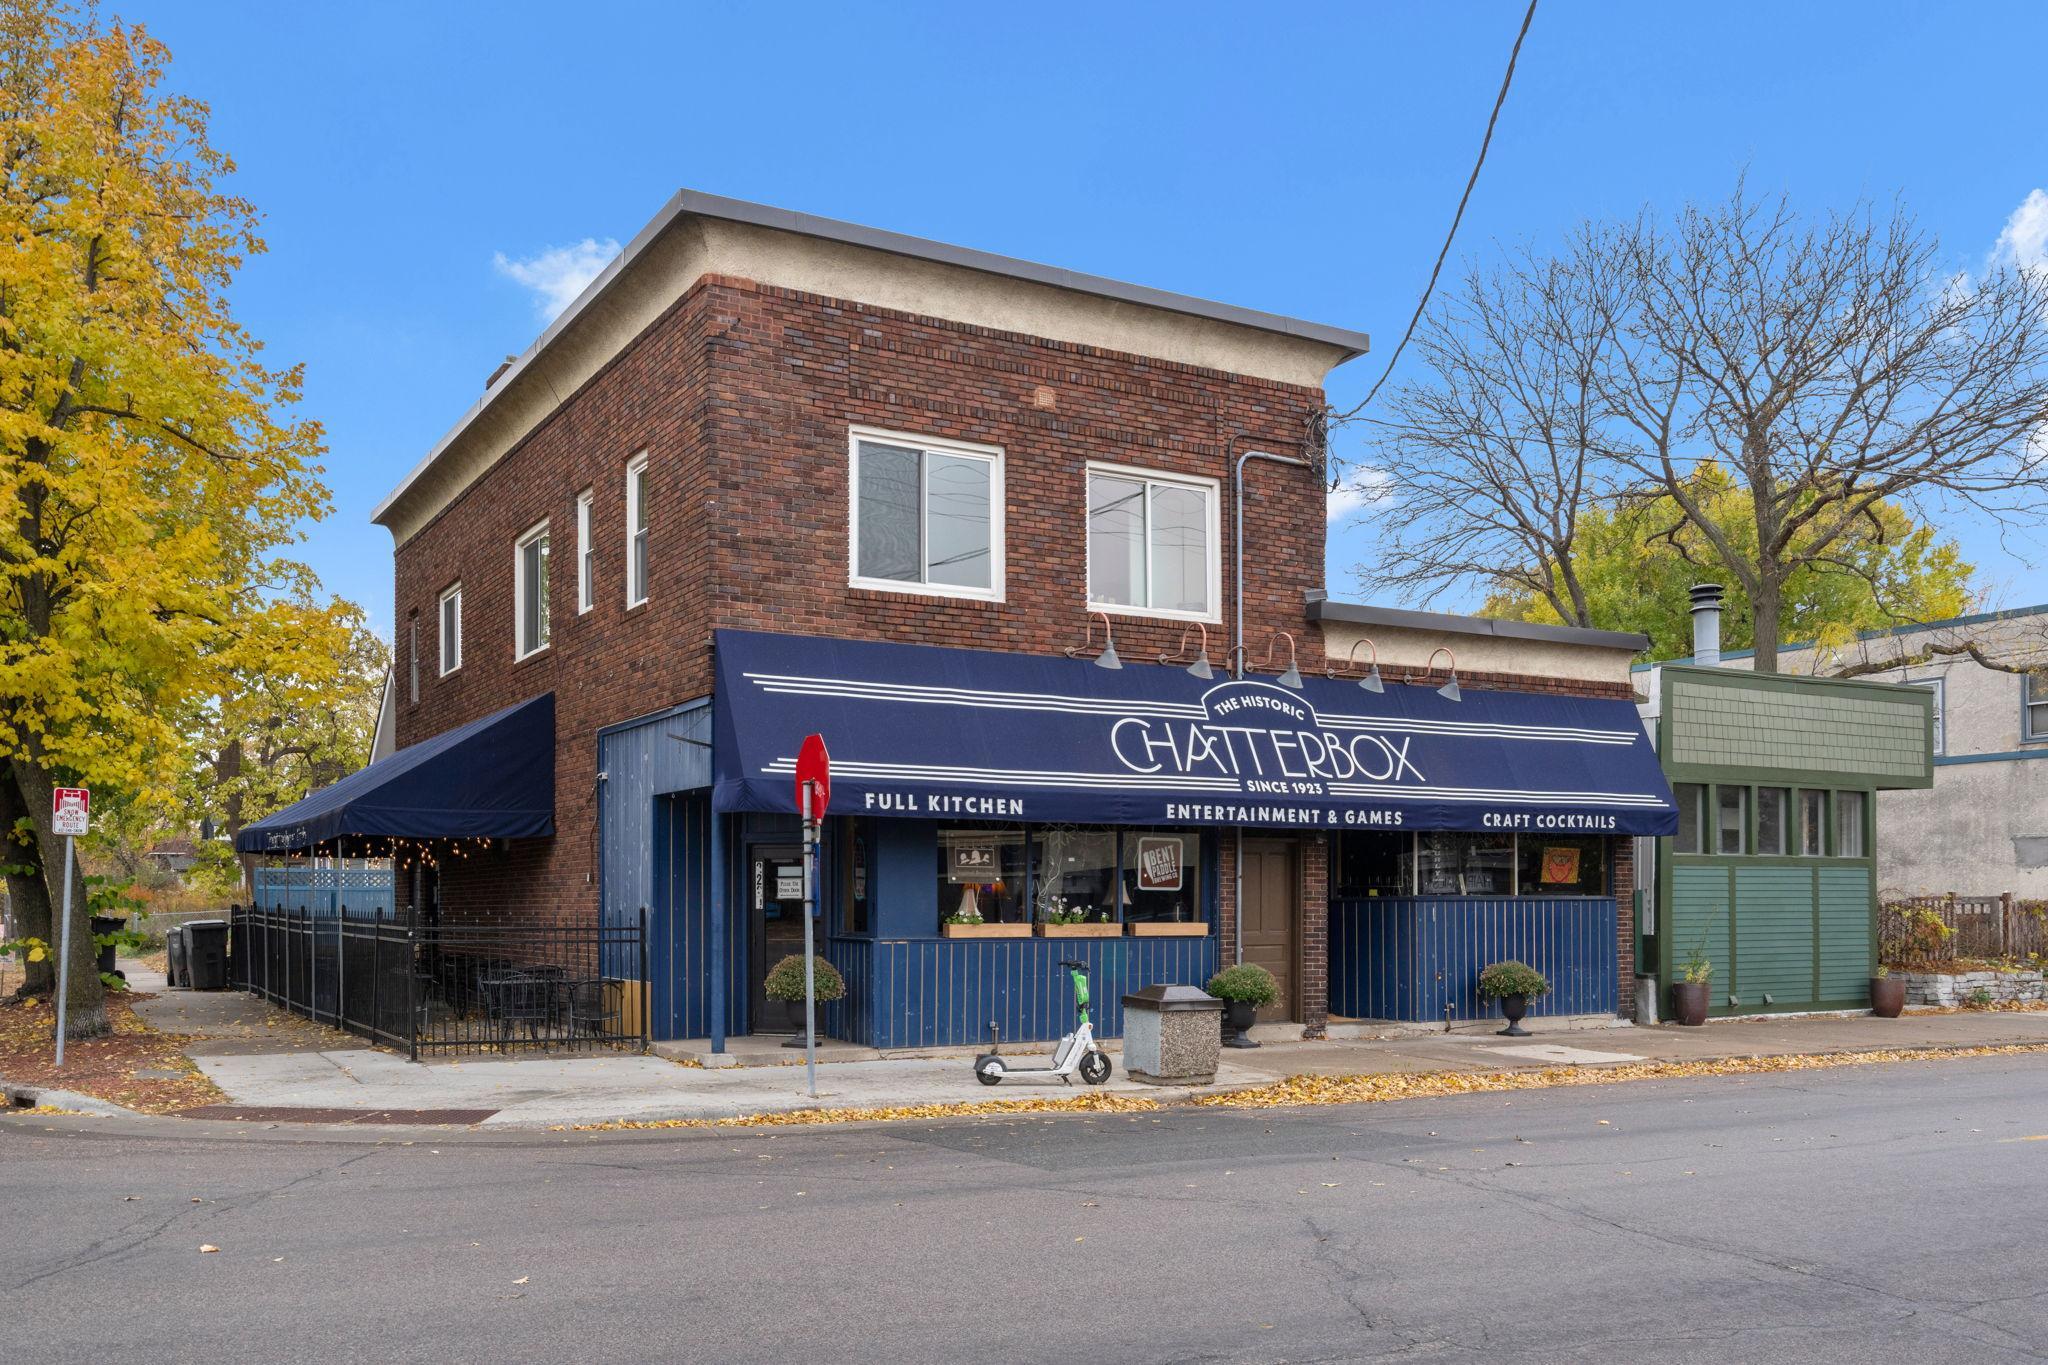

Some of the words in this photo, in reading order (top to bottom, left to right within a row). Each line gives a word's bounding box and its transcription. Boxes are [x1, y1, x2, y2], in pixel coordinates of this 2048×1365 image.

[1214, 697, 1240, 717] THE
[1242, 696, 1305, 720] HISTORIC
[1110, 717, 1426, 782] CHATTERBOX
[1246, 779, 1289, 794] SINCE
[1291, 781, 1323, 795] 1923
[865, 792, 918, 811] FULL
[928, 795, 1023, 815] KITCHEN
[1166, 803, 1320, 824] ENTERTAINMENT
[1327, 809, 1338, 824] &
[1344, 809, 1403, 825] GAMES
[1483, 812, 1531, 828] CRAFT
[1536, 814, 1616, 829] COCKTAILS
[1149, 845, 1175, 866] BENT
